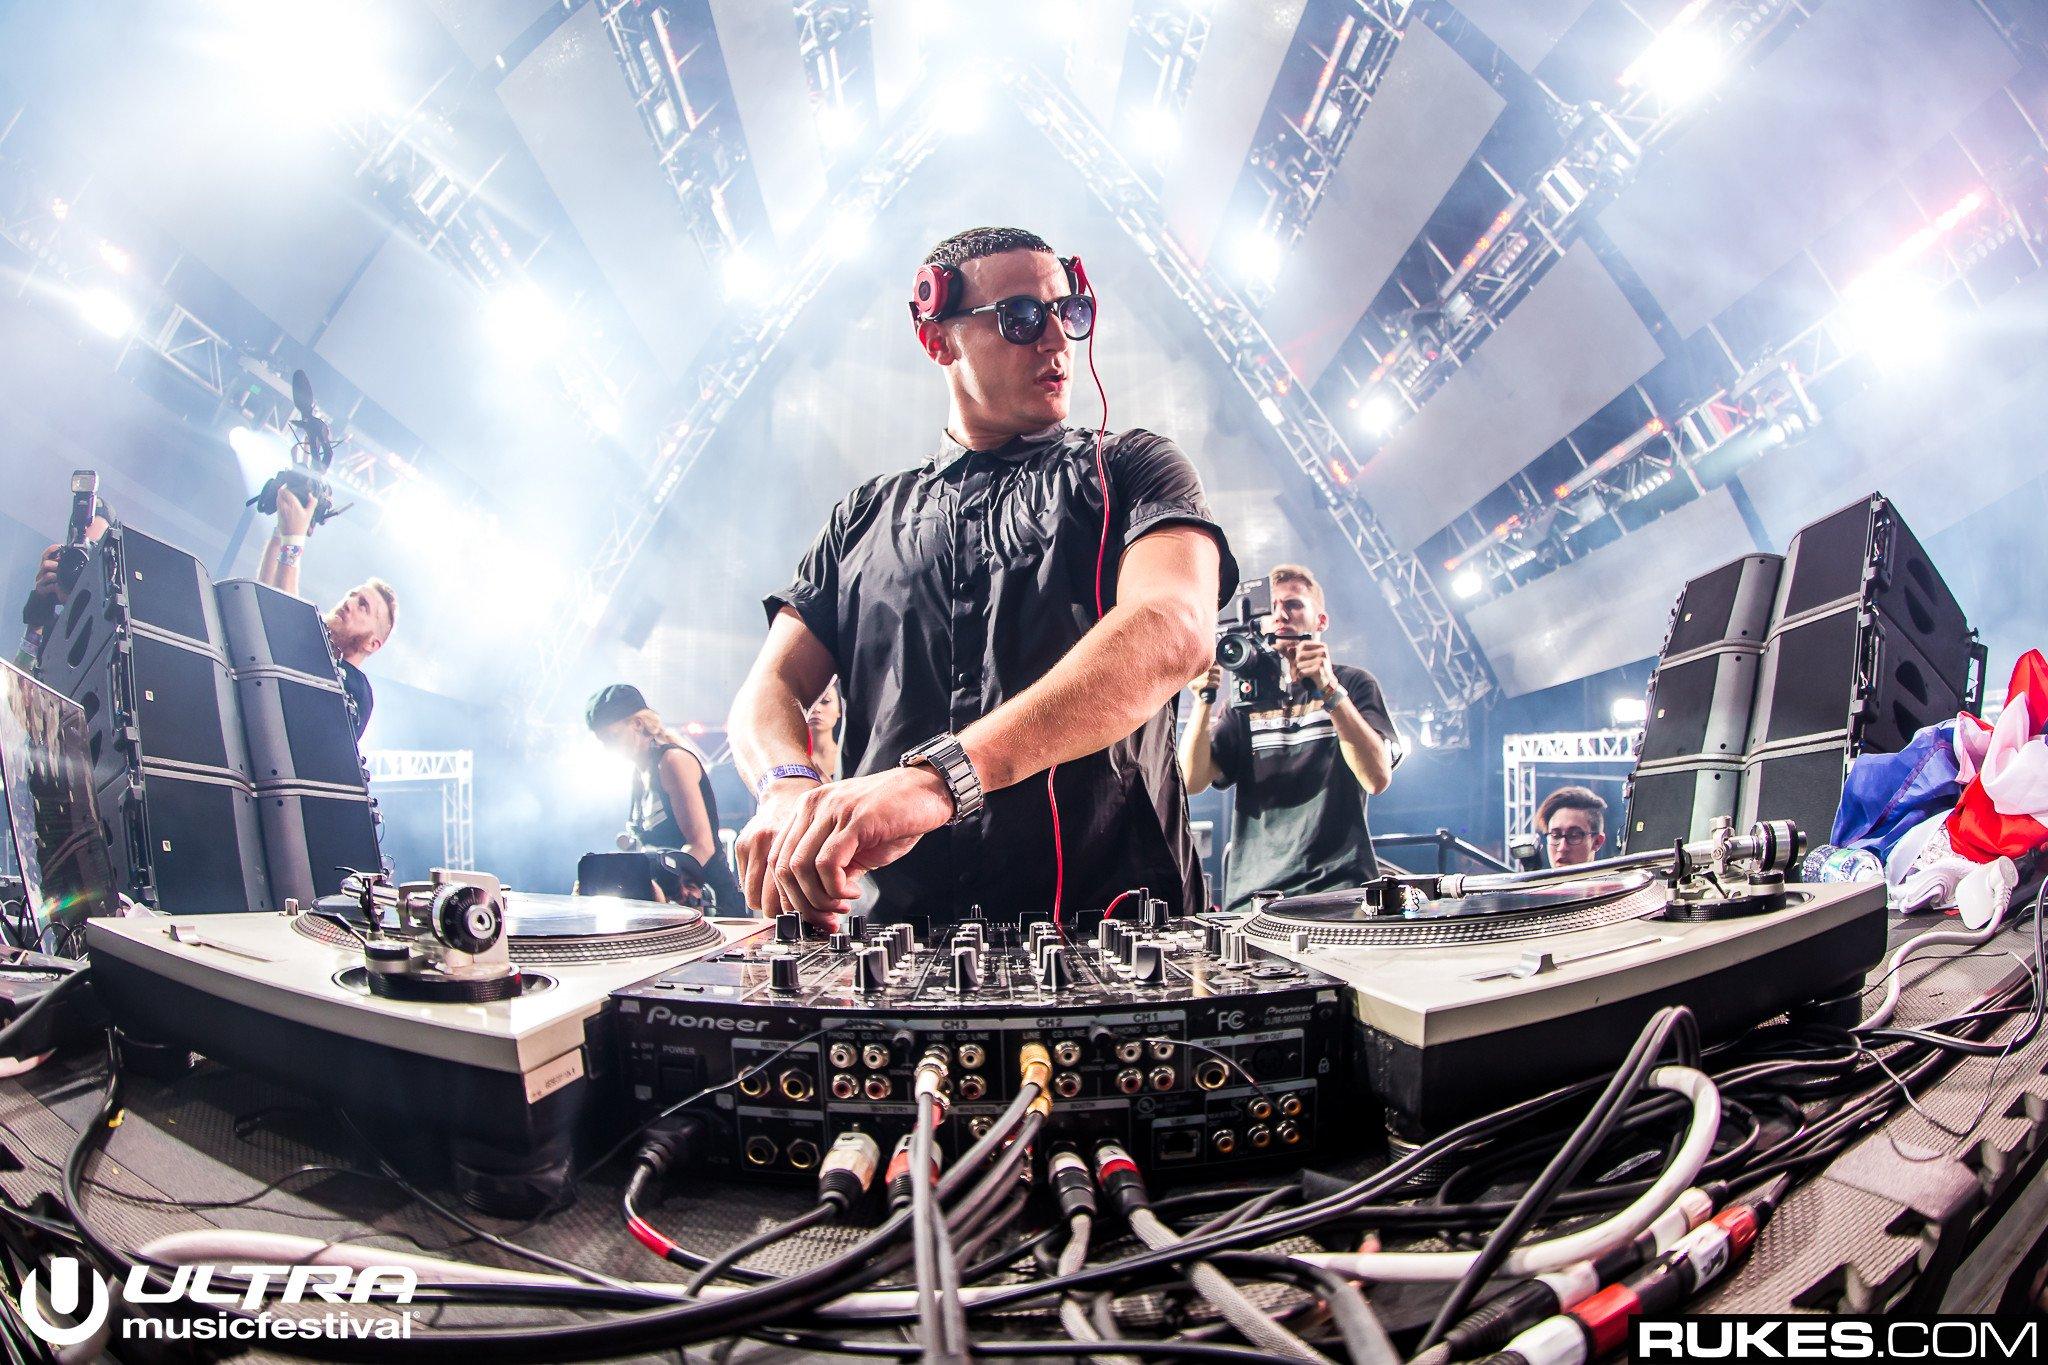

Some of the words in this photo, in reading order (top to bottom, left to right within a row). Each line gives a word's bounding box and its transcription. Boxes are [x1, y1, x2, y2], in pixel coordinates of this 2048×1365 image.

[646, 1006, 771, 1032] Pioneer
[1036, 1018, 1063, 1028] CH2
[941, 1020, 968, 1030] CH3
[662, 1045, 697, 1055] POWER
